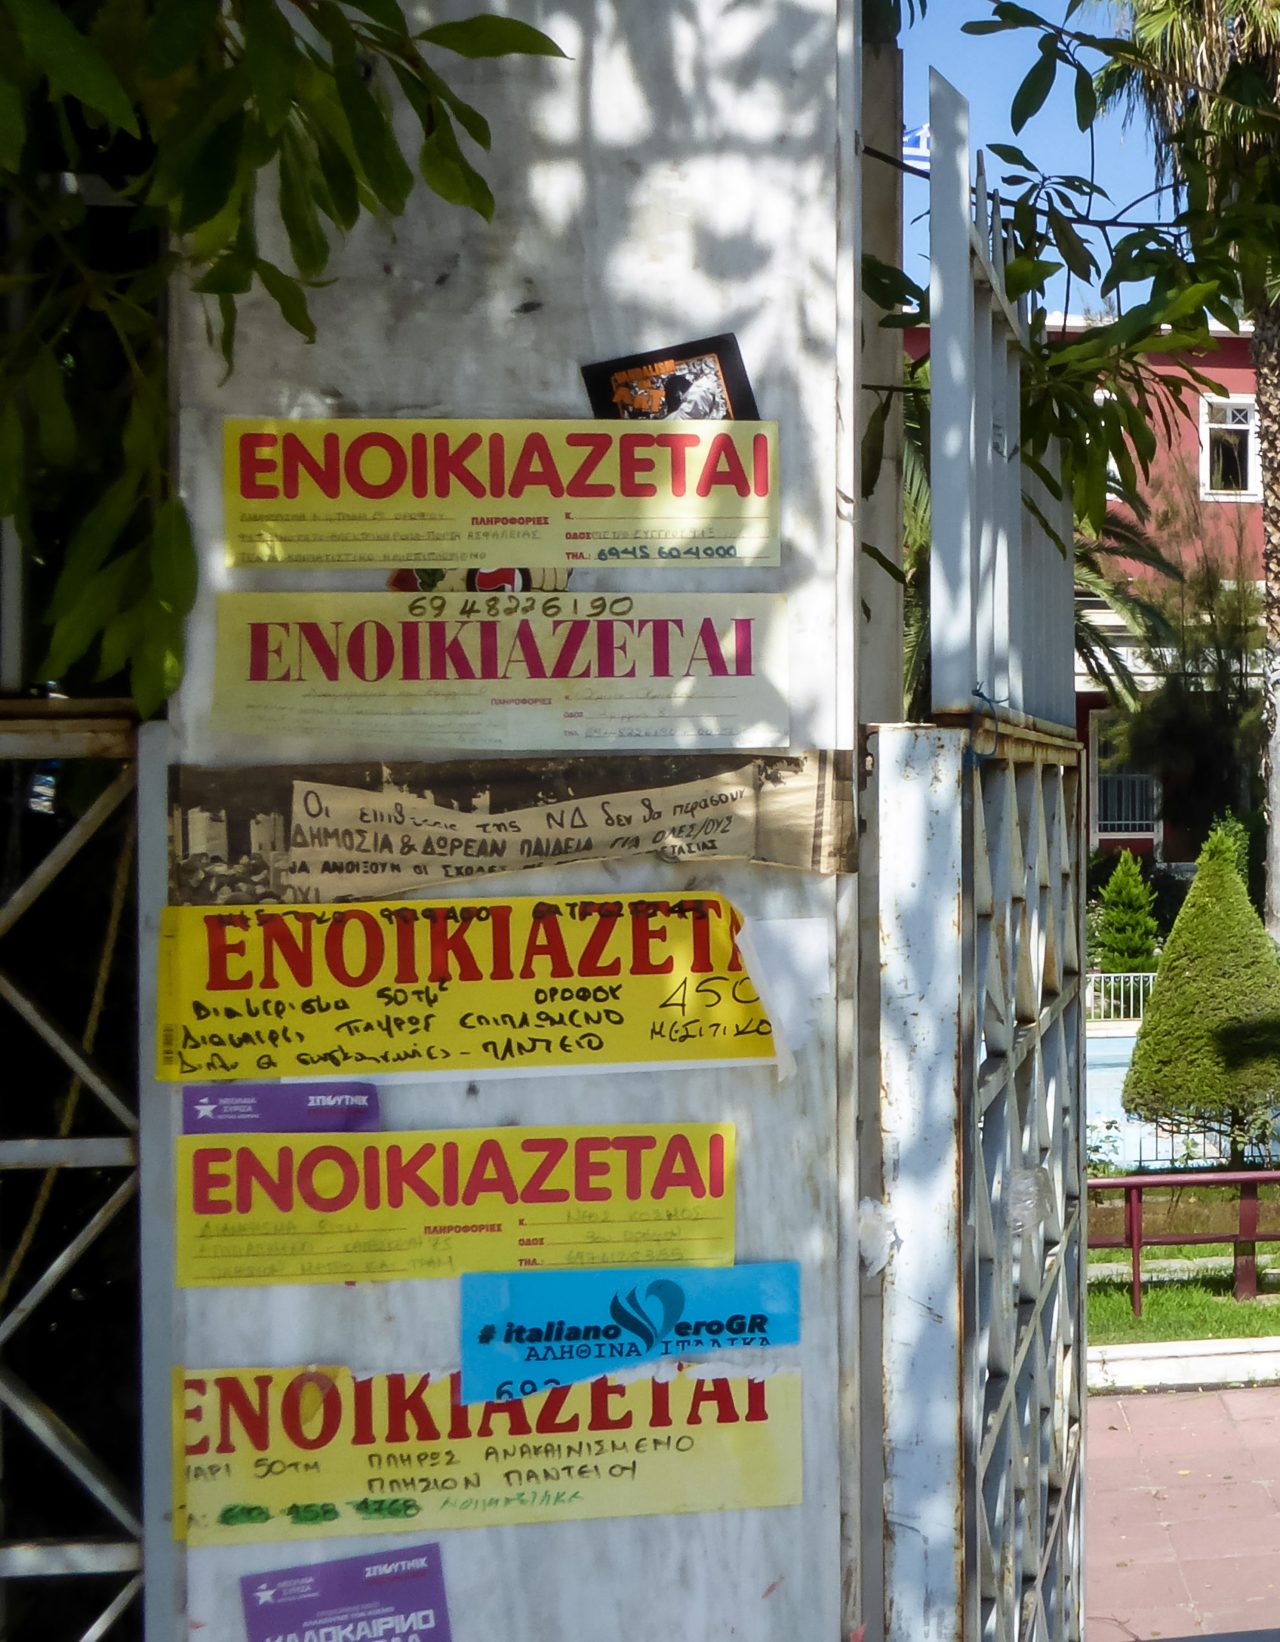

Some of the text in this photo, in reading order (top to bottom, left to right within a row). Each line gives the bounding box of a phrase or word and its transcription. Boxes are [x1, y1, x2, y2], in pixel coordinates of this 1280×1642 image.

[239, 433, 769, 499] ΕΝΟΙΚΙΑΖΕΤΑΙ
[471, 516, 550, 526] ΠΛΗΡΟΦΟΡΙΕΣ
[565, 531, 592, 540] ΟΔΟΣ
[407, 596, 447, 618] 69
[247, 618, 756, 684] ΕΝΟΙΚΙΑΖΕΤΑΙ
[546, 806, 589, 830] ΝΔ
[601, 801, 633, 827] δεν
[641, 797, 662, 824] θα
[290, 823, 394, 854] ΔΗΜΟΣΙΑ
[400, 834, 418, 856] &
[421, 834, 507, 858] ΔΩΡΕΑΝ
[519, 836, 593, 858] ΠΑΙΔΕΙΑ
[321, 860, 402, 875] ΑΝΟΙΞΟΥΝ
[193, 1133, 725, 1215] ΕΝΟΙΚΙΑΖΕΤΑΙ
[424, 1224, 504, 1235] ΠΛΗΡΟΦΟΡΙΕΣ
[518, 1237, 545, 1247] ΟΔΟΣ
[524, 1341, 643, 1361] ΑΛΗΘΙΝΑ
